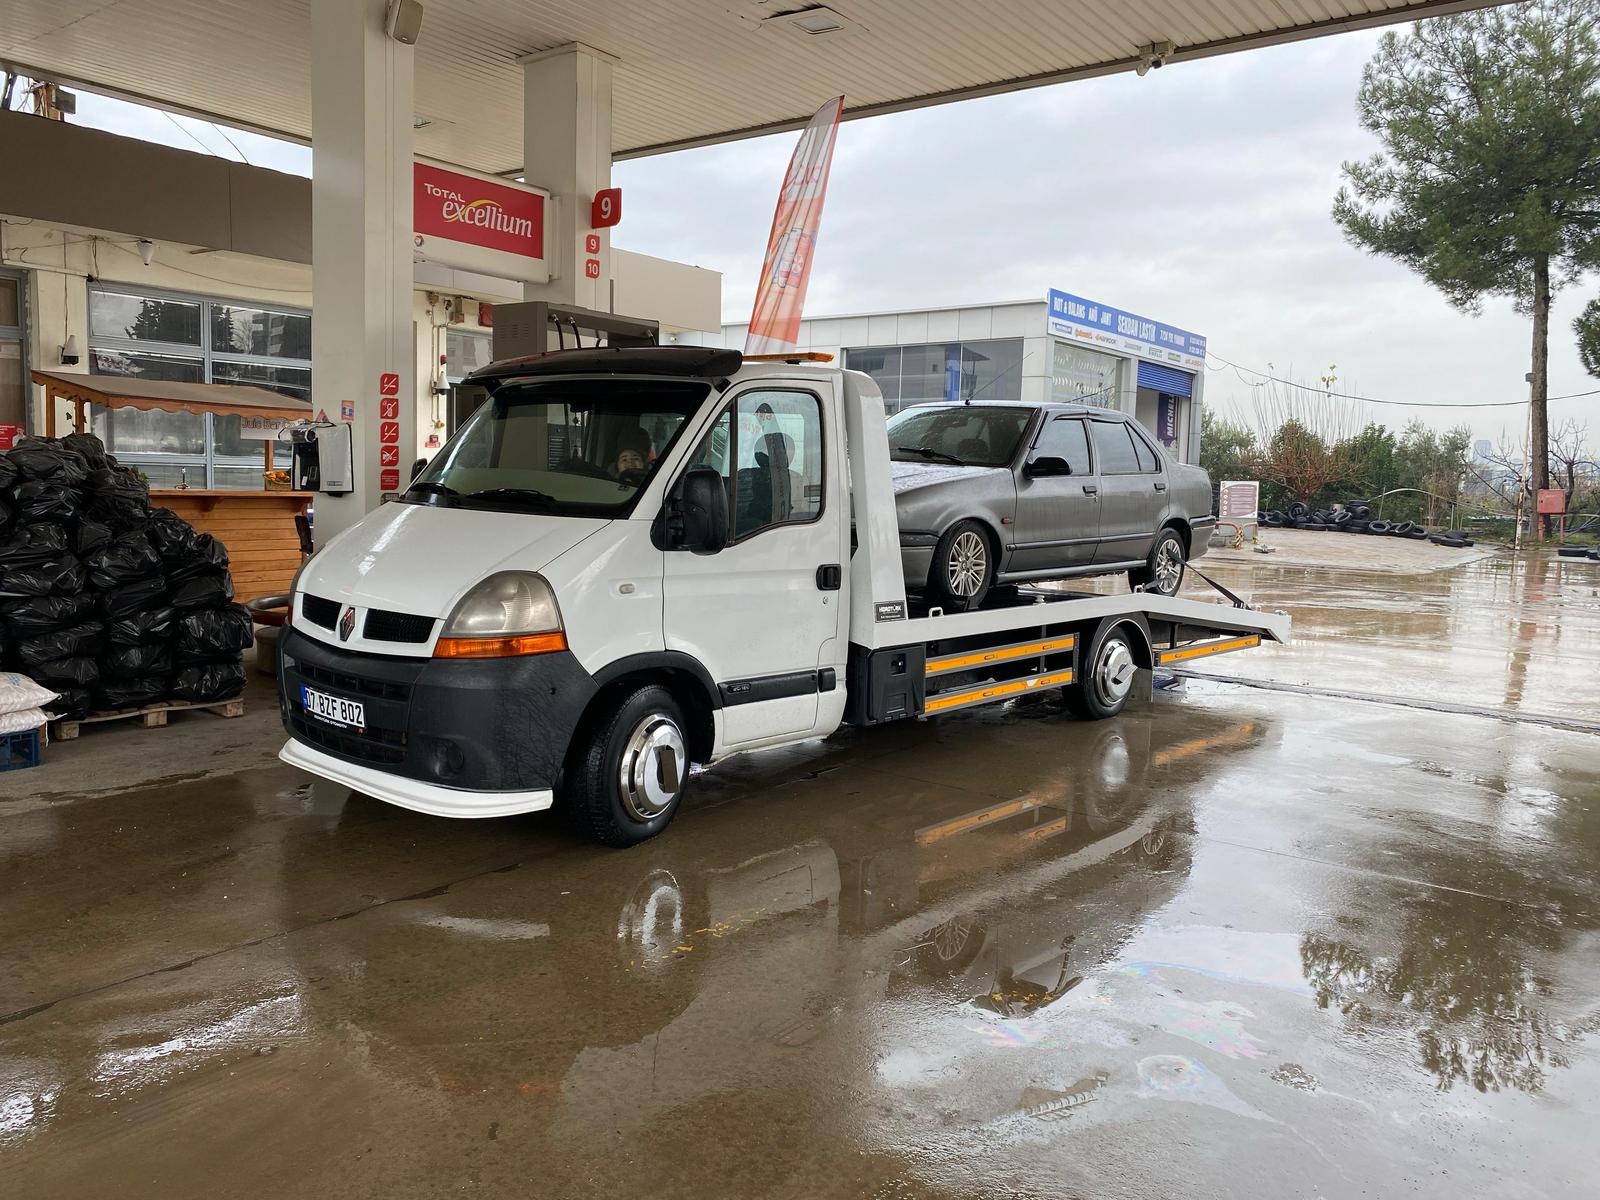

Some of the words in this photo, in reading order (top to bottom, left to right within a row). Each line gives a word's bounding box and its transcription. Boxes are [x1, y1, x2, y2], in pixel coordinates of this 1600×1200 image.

[424, 183, 466, 203] TOTAL
[442, 200, 533, 238] excellium
[601, 196, 612, 219] 9
[590, 238, 597, 250] 9
[587, 263, 599, 275] 10
[1167, 393, 1175, 437] MICHEL
[305, 690, 315, 710] 07
[319, 694, 337, 717] BZF
[340, 701, 363, 725] 802
